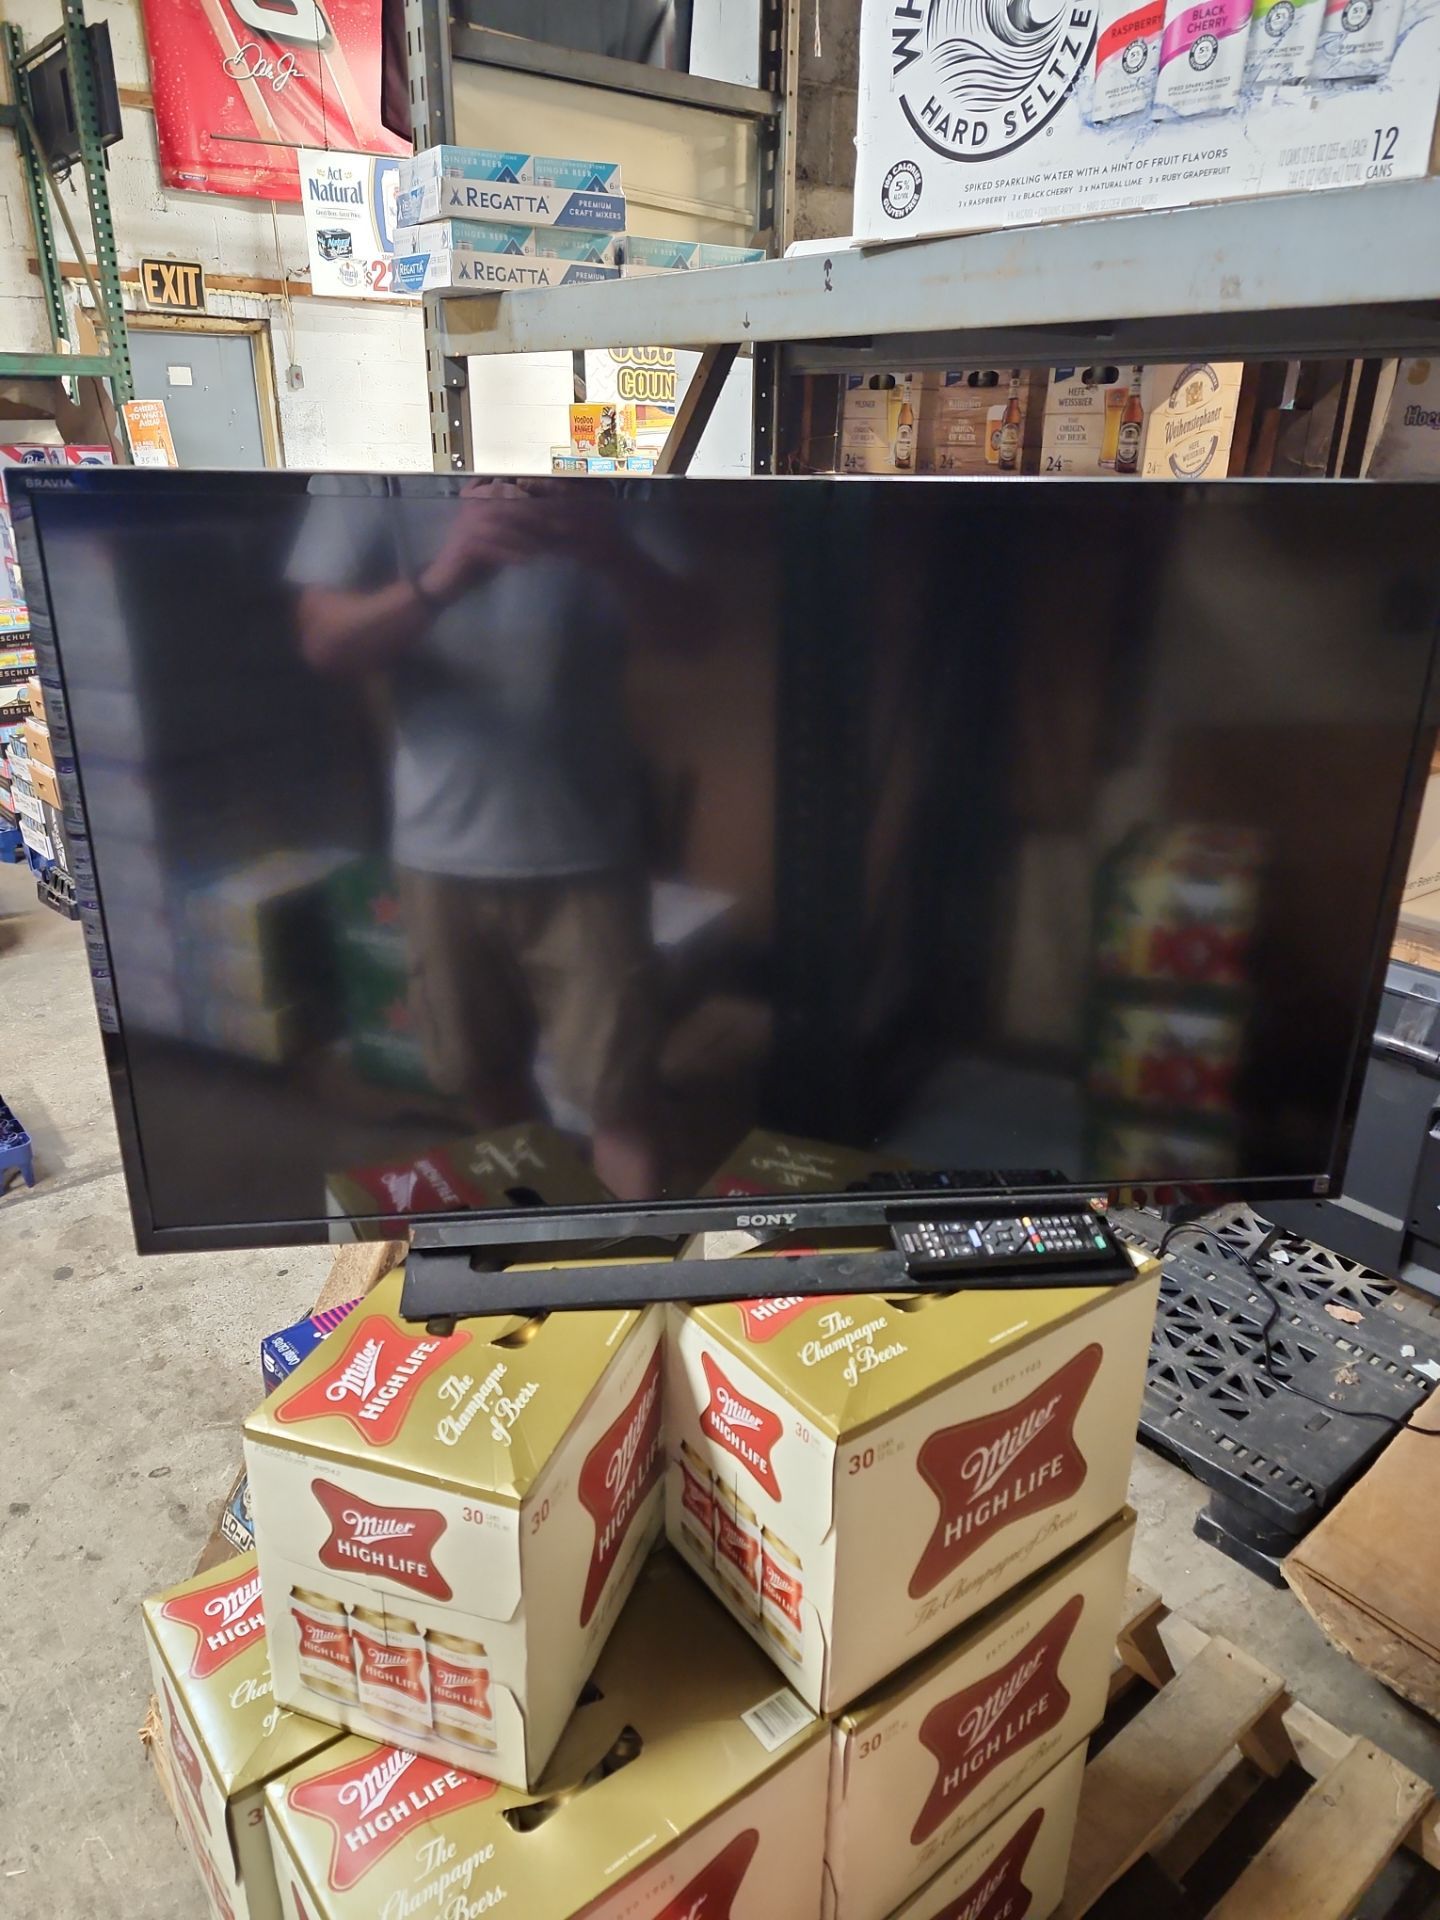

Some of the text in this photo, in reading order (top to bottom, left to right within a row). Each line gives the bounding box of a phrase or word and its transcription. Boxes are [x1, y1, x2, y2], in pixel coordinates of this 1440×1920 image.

[1187, 16, 1228, 34] CHERRY
[1193, 5, 1225, 21] BLACK
[1111, 15, 1162, 38] RASPBERRY
[921, 96, 988, 146] HARD
[1372, 126, 1399, 162] 12
[327, 167, 342, 181] Act
[444, 155, 503, 169] GINGER BEER
[537, 166, 592, 178] GINGER BEER
[892, 160, 922, 185] CALORIES
[964, 148, 1229, 193] SPIKED SPARKLING WATER WITH A HINT OF FRUIT FLAVORS
[1366, 163, 1393, 179] CANS
[521, 174, 527, 182] 6
[894, 180, 910, 192] 5%
[1023, 191, 1044, 200] BLACK
[1046, 187, 1073, 197] CHERRY
[1090, 181, 1122, 191] NATURAL
[1124, 178, 1143, 187] LIME
[1161, 173, 1181, 183] RUBY
[1183, 166, 1231, 180] GRAPEFRUIT
[308, 178, 364, 205] Natural
[467, 187, 550, 214] REGATTA
[569, 208, 622, 220] CRAFT MIXERS
[578, 200, 612, 210] PREMIUM
[883, 193, 921, 219] GLUTEN FREE
[400, 261, 423, 275] REGATTA
[474, 262, 550, 285] REGATTA
[576, 271, 605, 281] PREMIUM
[144, 263, 199, 306] EXIT
[1058, 397, 1093, 408] WEISSBIER
[1068, 387, 1086, 397] HEFE
[574, 424, 594, 433] RANGER
[951, 425, 975, 433] ORIGIN
[1056, 433, 1087, 441] OF BEER
[1059, 424, 1086, 433] ORIGIN
[1165, 406, 1223, 444] Weihenstephaner
[844, 454, 857, 467] 24
[939, 454, 954, 469] 24
[1045, 456, 1063, 472] 24
[26, 478, 73, 489] BRAVIA
[736, 1213, 797, 1228] SONY
[819, 1311, 854, 1339] The
[798, 1316, 888, 1367] Champagne
[326, 1338, 384, 1401] Miller
[843, 1357, 859, 1387] of
[358, 1370, 408, 1420] HIGH
[433, 1362, 508, 1446] Champagne
[438, 1375, 474, 1411] The
[716, 1387, 763, 1431] Miller
[490, 1415, 512, 1447] of
[605, 1371, 660, 1511] Miller
[710, 1412, 740, 1449] HIGH
[795, 1422, 810, 1443] 30
[961, 1394, 1062, 1502] Miller
[849, 1448, 875, 1475] 30
[944, 1454, 1064, 1548] HIGH LIFE
[342, 1509, 416, 1544] Miller
[462, 1507, 483, 1525] 30
[531, 1499, 549, 1535] 30
[599, 1479, 636, 1563] HIGH
[337, 1539, 429, 1578] HIGH LIFE
[764, 1581, 782, 1601] HIGH
[767, 1566, 795, 1592] Miller
[305, 1625, 343, 1643] Miller
[303, 1640, 351, 1664] HIGH LIFE
[368, 1648, 411, 1669] Miller
[365, 1664, 394, 1682] HIGH
[395, 1675, 419, 1691] LIFE
[436, 1670, 479, 1688] Miller
[434, 1686, 485, 1709] HIGH LIFE
[957, 1645, 1048, 1757] Miller
[262, 1706, 281, 1737] of
[858, 1733, 882, 1759] 30
[943, 1693, 1050, 1796] HIGH LIFE
[344, 1799, 411, 1852] HIGH
[414, 1833, 457, 1883] The
[379, 1843, 496, 1920] Champagne
